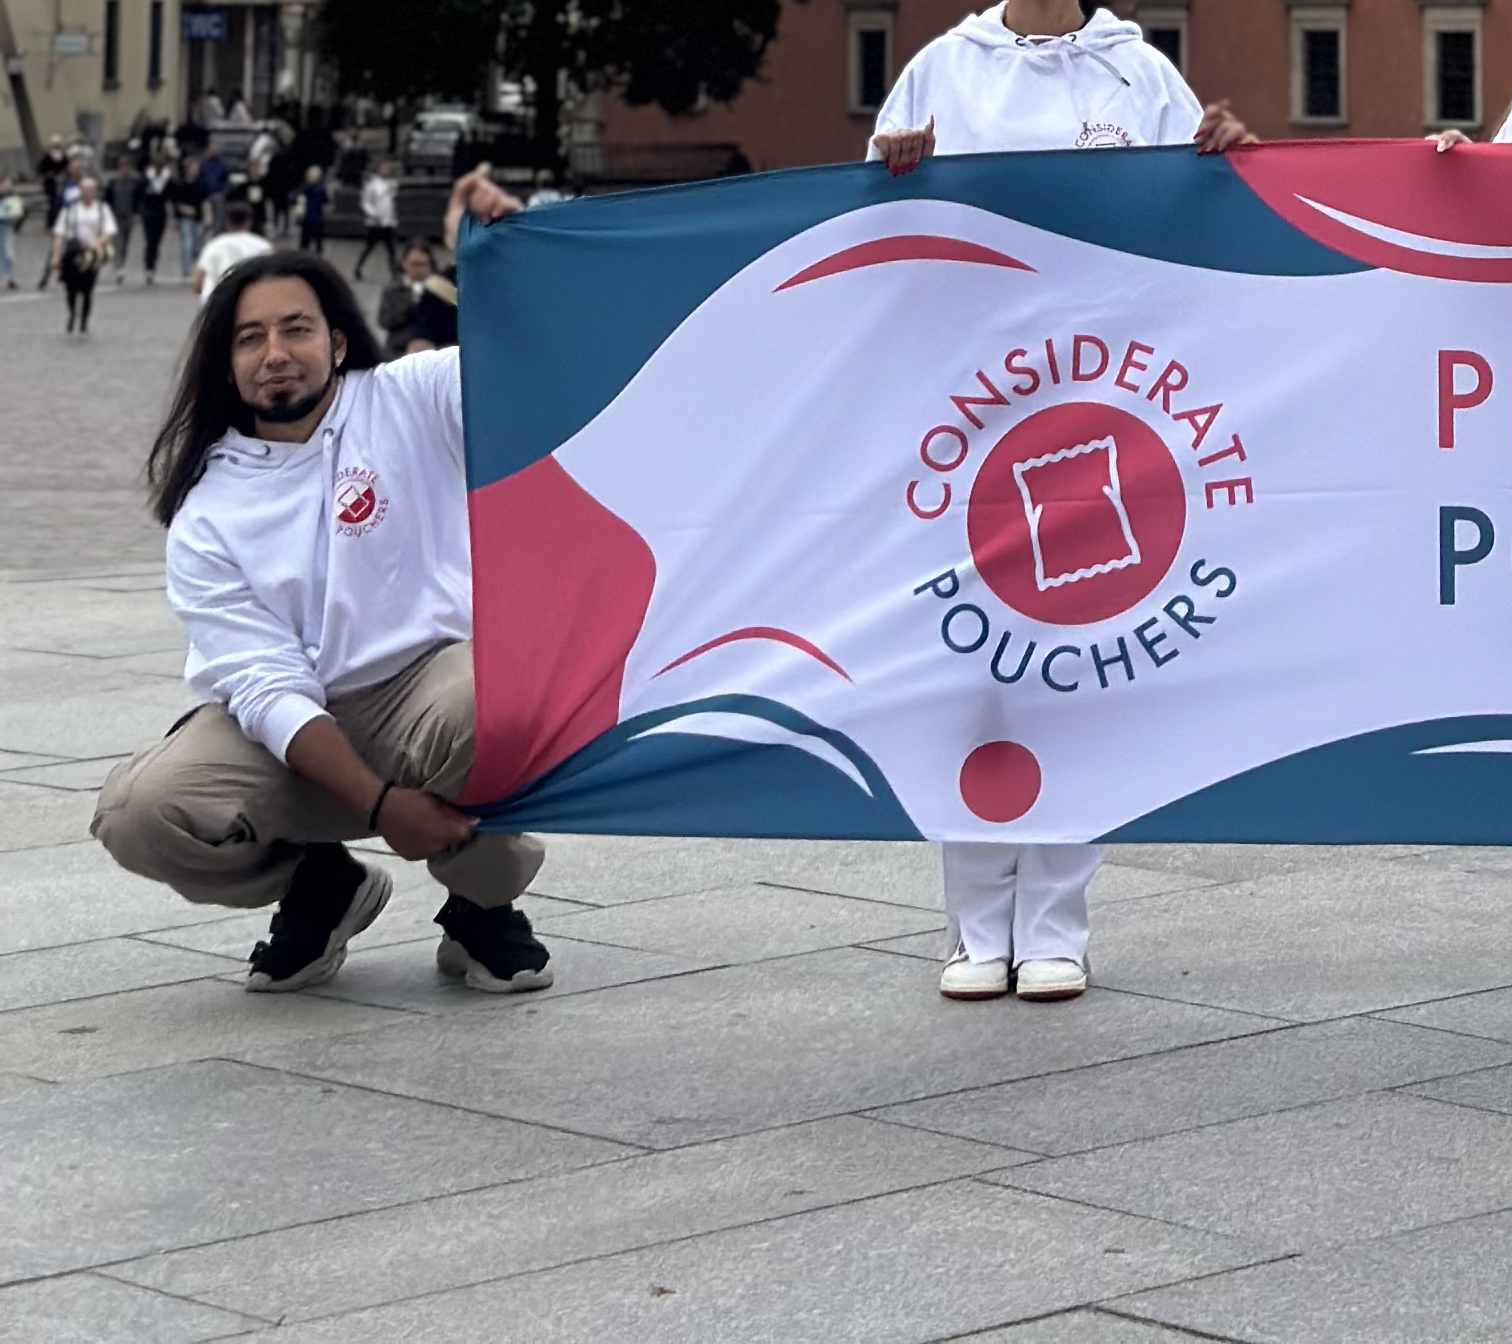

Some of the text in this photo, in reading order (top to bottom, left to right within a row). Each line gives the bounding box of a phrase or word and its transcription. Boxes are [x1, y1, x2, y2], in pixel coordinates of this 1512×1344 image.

[1075, 123, 1132, 148] CONSIDER
[906, 334, 1254, 520] CONSIDERATE
[913, 558, 1237, 693] POUCHERS
